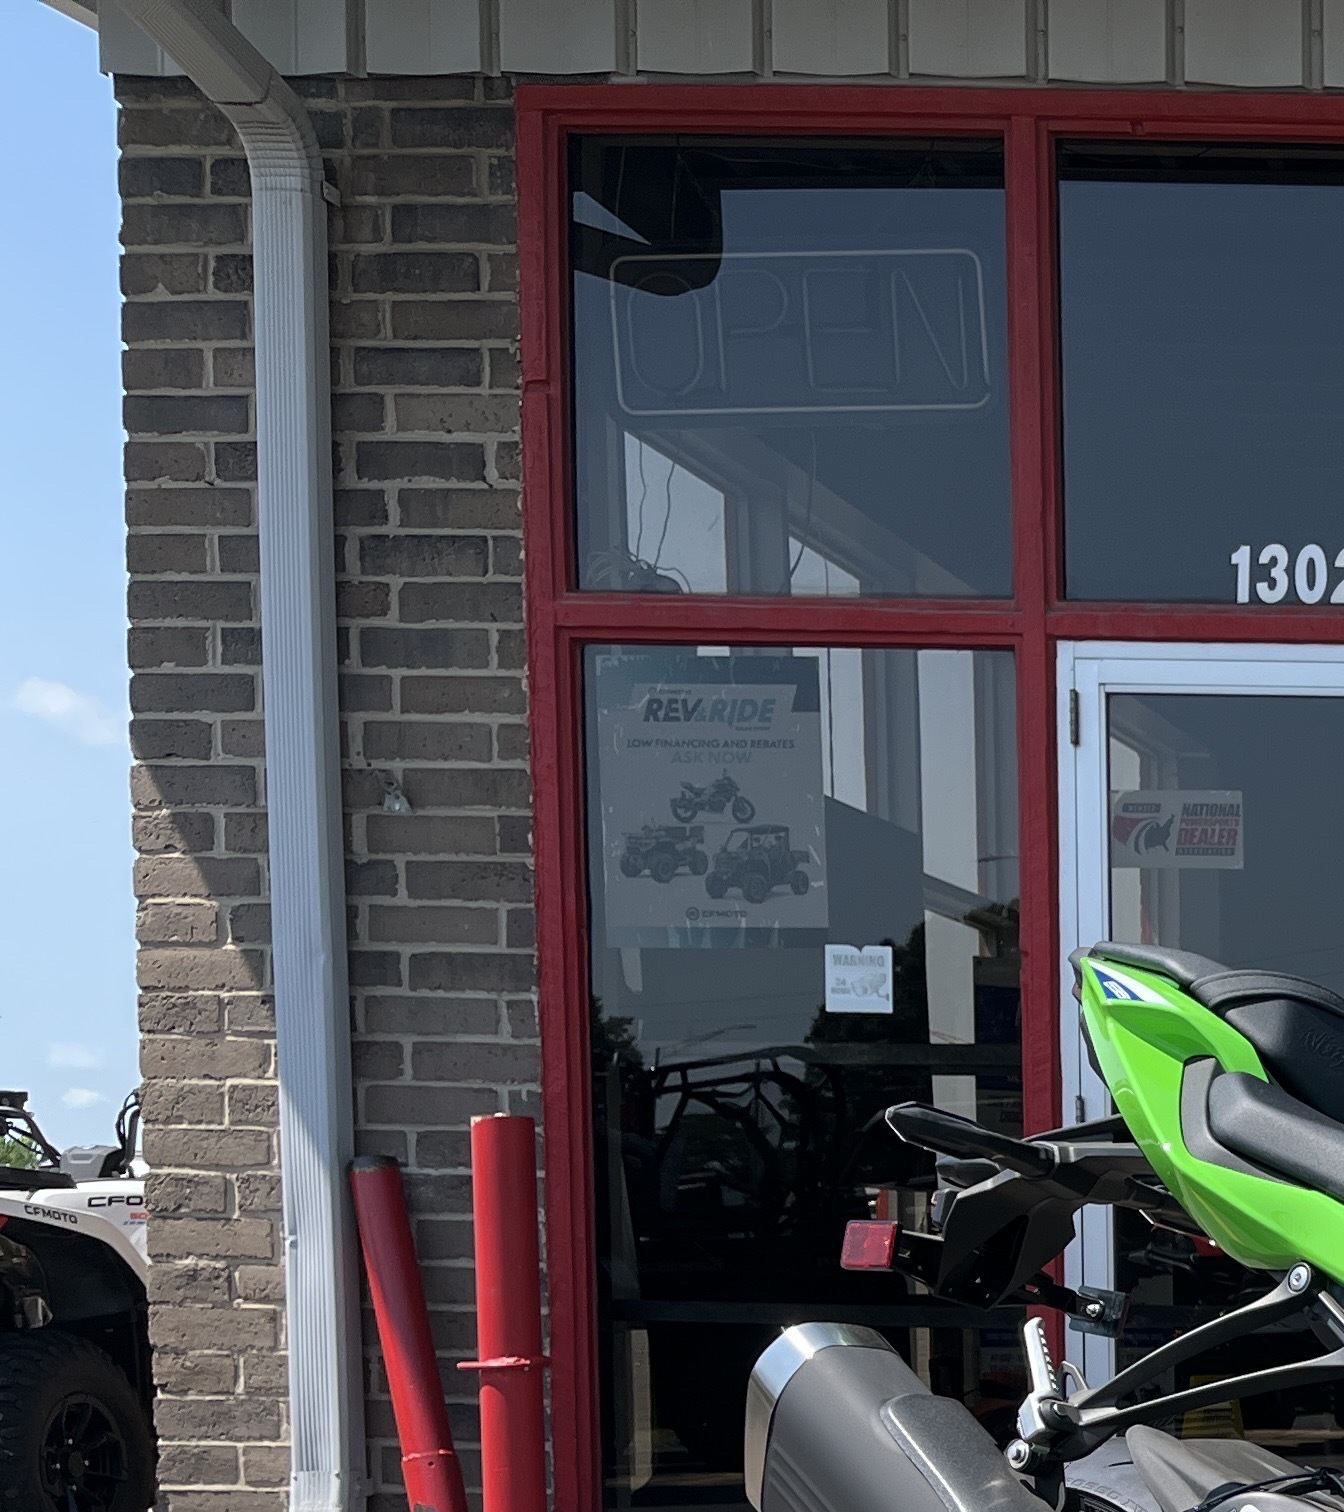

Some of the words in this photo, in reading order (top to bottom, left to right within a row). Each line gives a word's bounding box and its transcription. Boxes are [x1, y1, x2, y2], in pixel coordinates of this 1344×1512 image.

[627, 268, 968, 397] OPEN
[626, 740, 653, 748] LOW
[655, 740, 720, 748] FINANCING
[722, 740, 747, 748] AND
[750, 740, 795, 749] REBATES
[671, 751, 704, 763] ASK
[708, 751, 753, 763] NOW
[1181, 803, 1240, 817] NATIONAL
[1176, 828, 1238, 846] DEALER
[24, 1204, 78, 1224] CFMOTO
